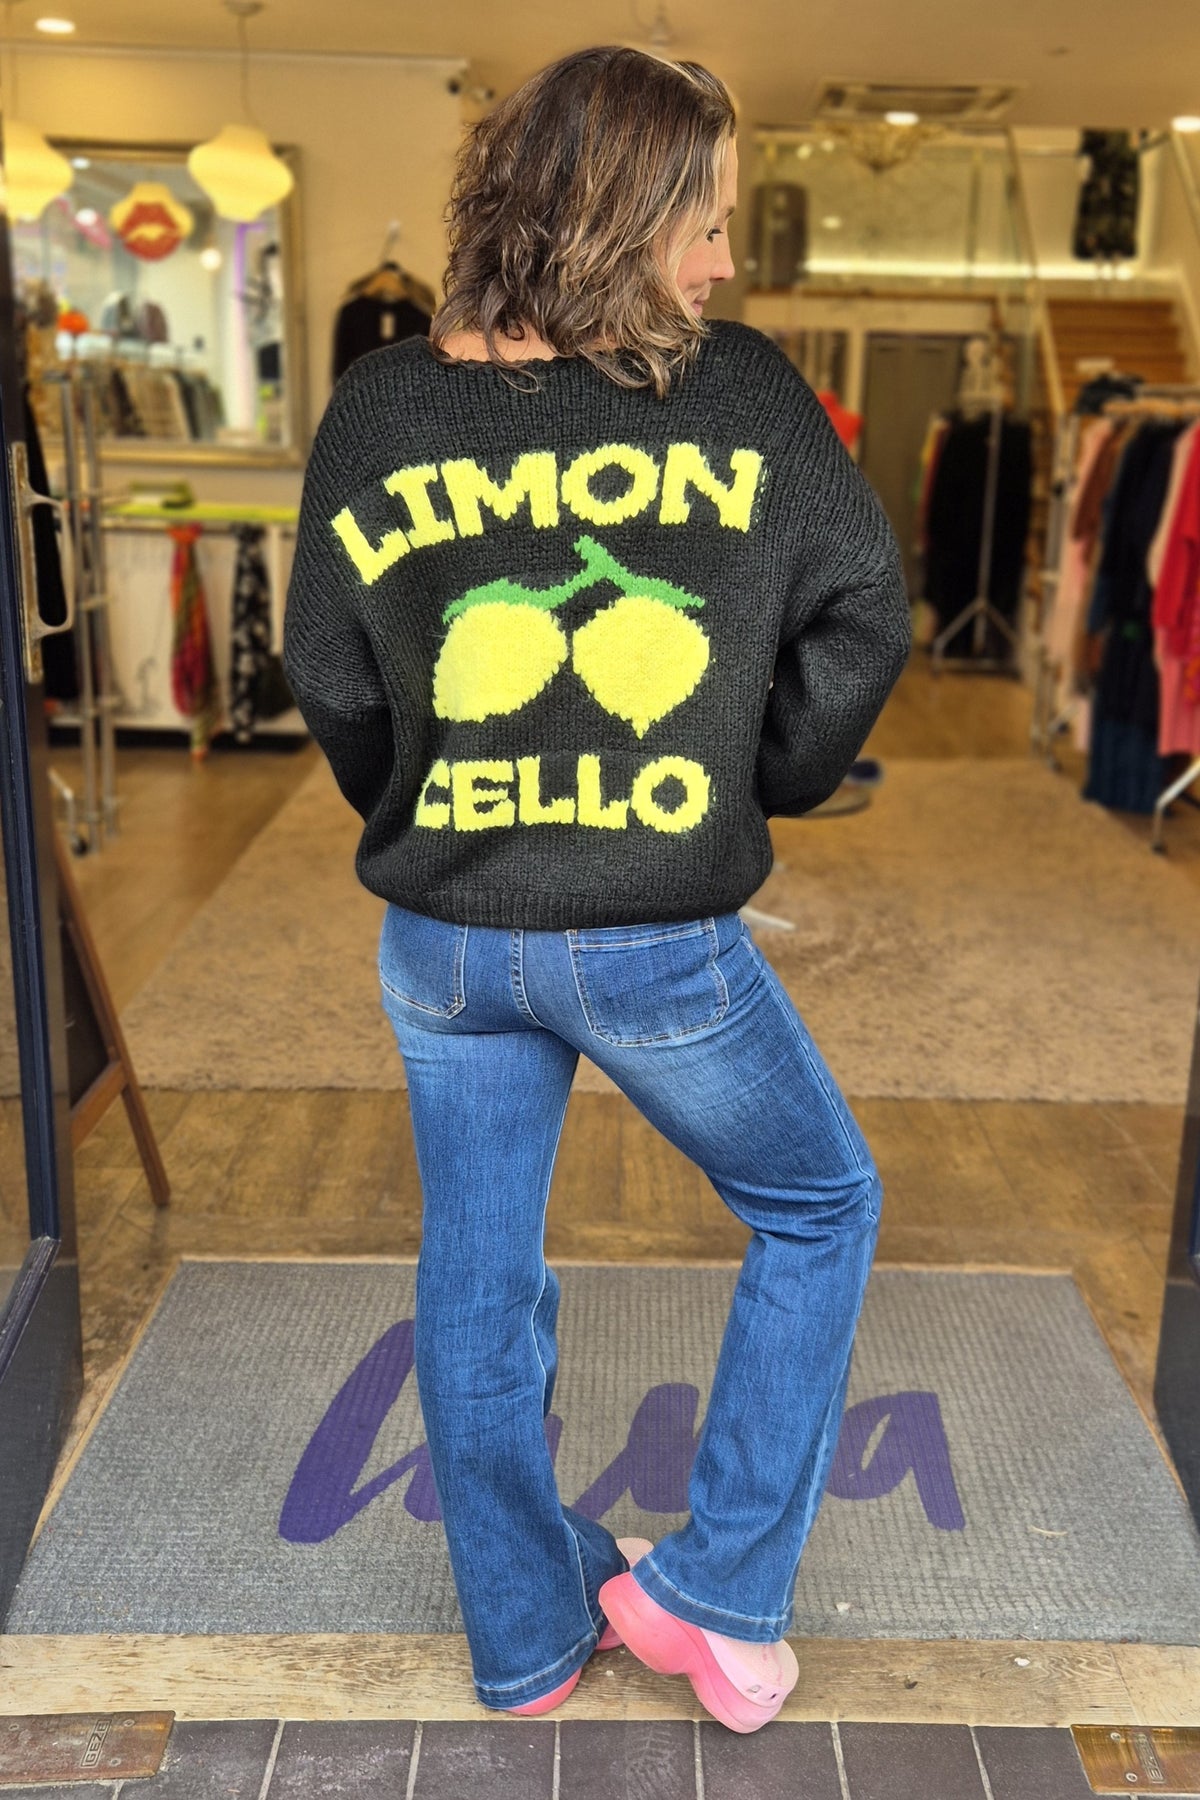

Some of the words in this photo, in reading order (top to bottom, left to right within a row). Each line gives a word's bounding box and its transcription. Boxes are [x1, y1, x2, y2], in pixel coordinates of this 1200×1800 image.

[331, 443, 764, 585] LIMON
[415, 754, 711, 834] CELLO
[84, 1721, 109, 1764] GEZE
